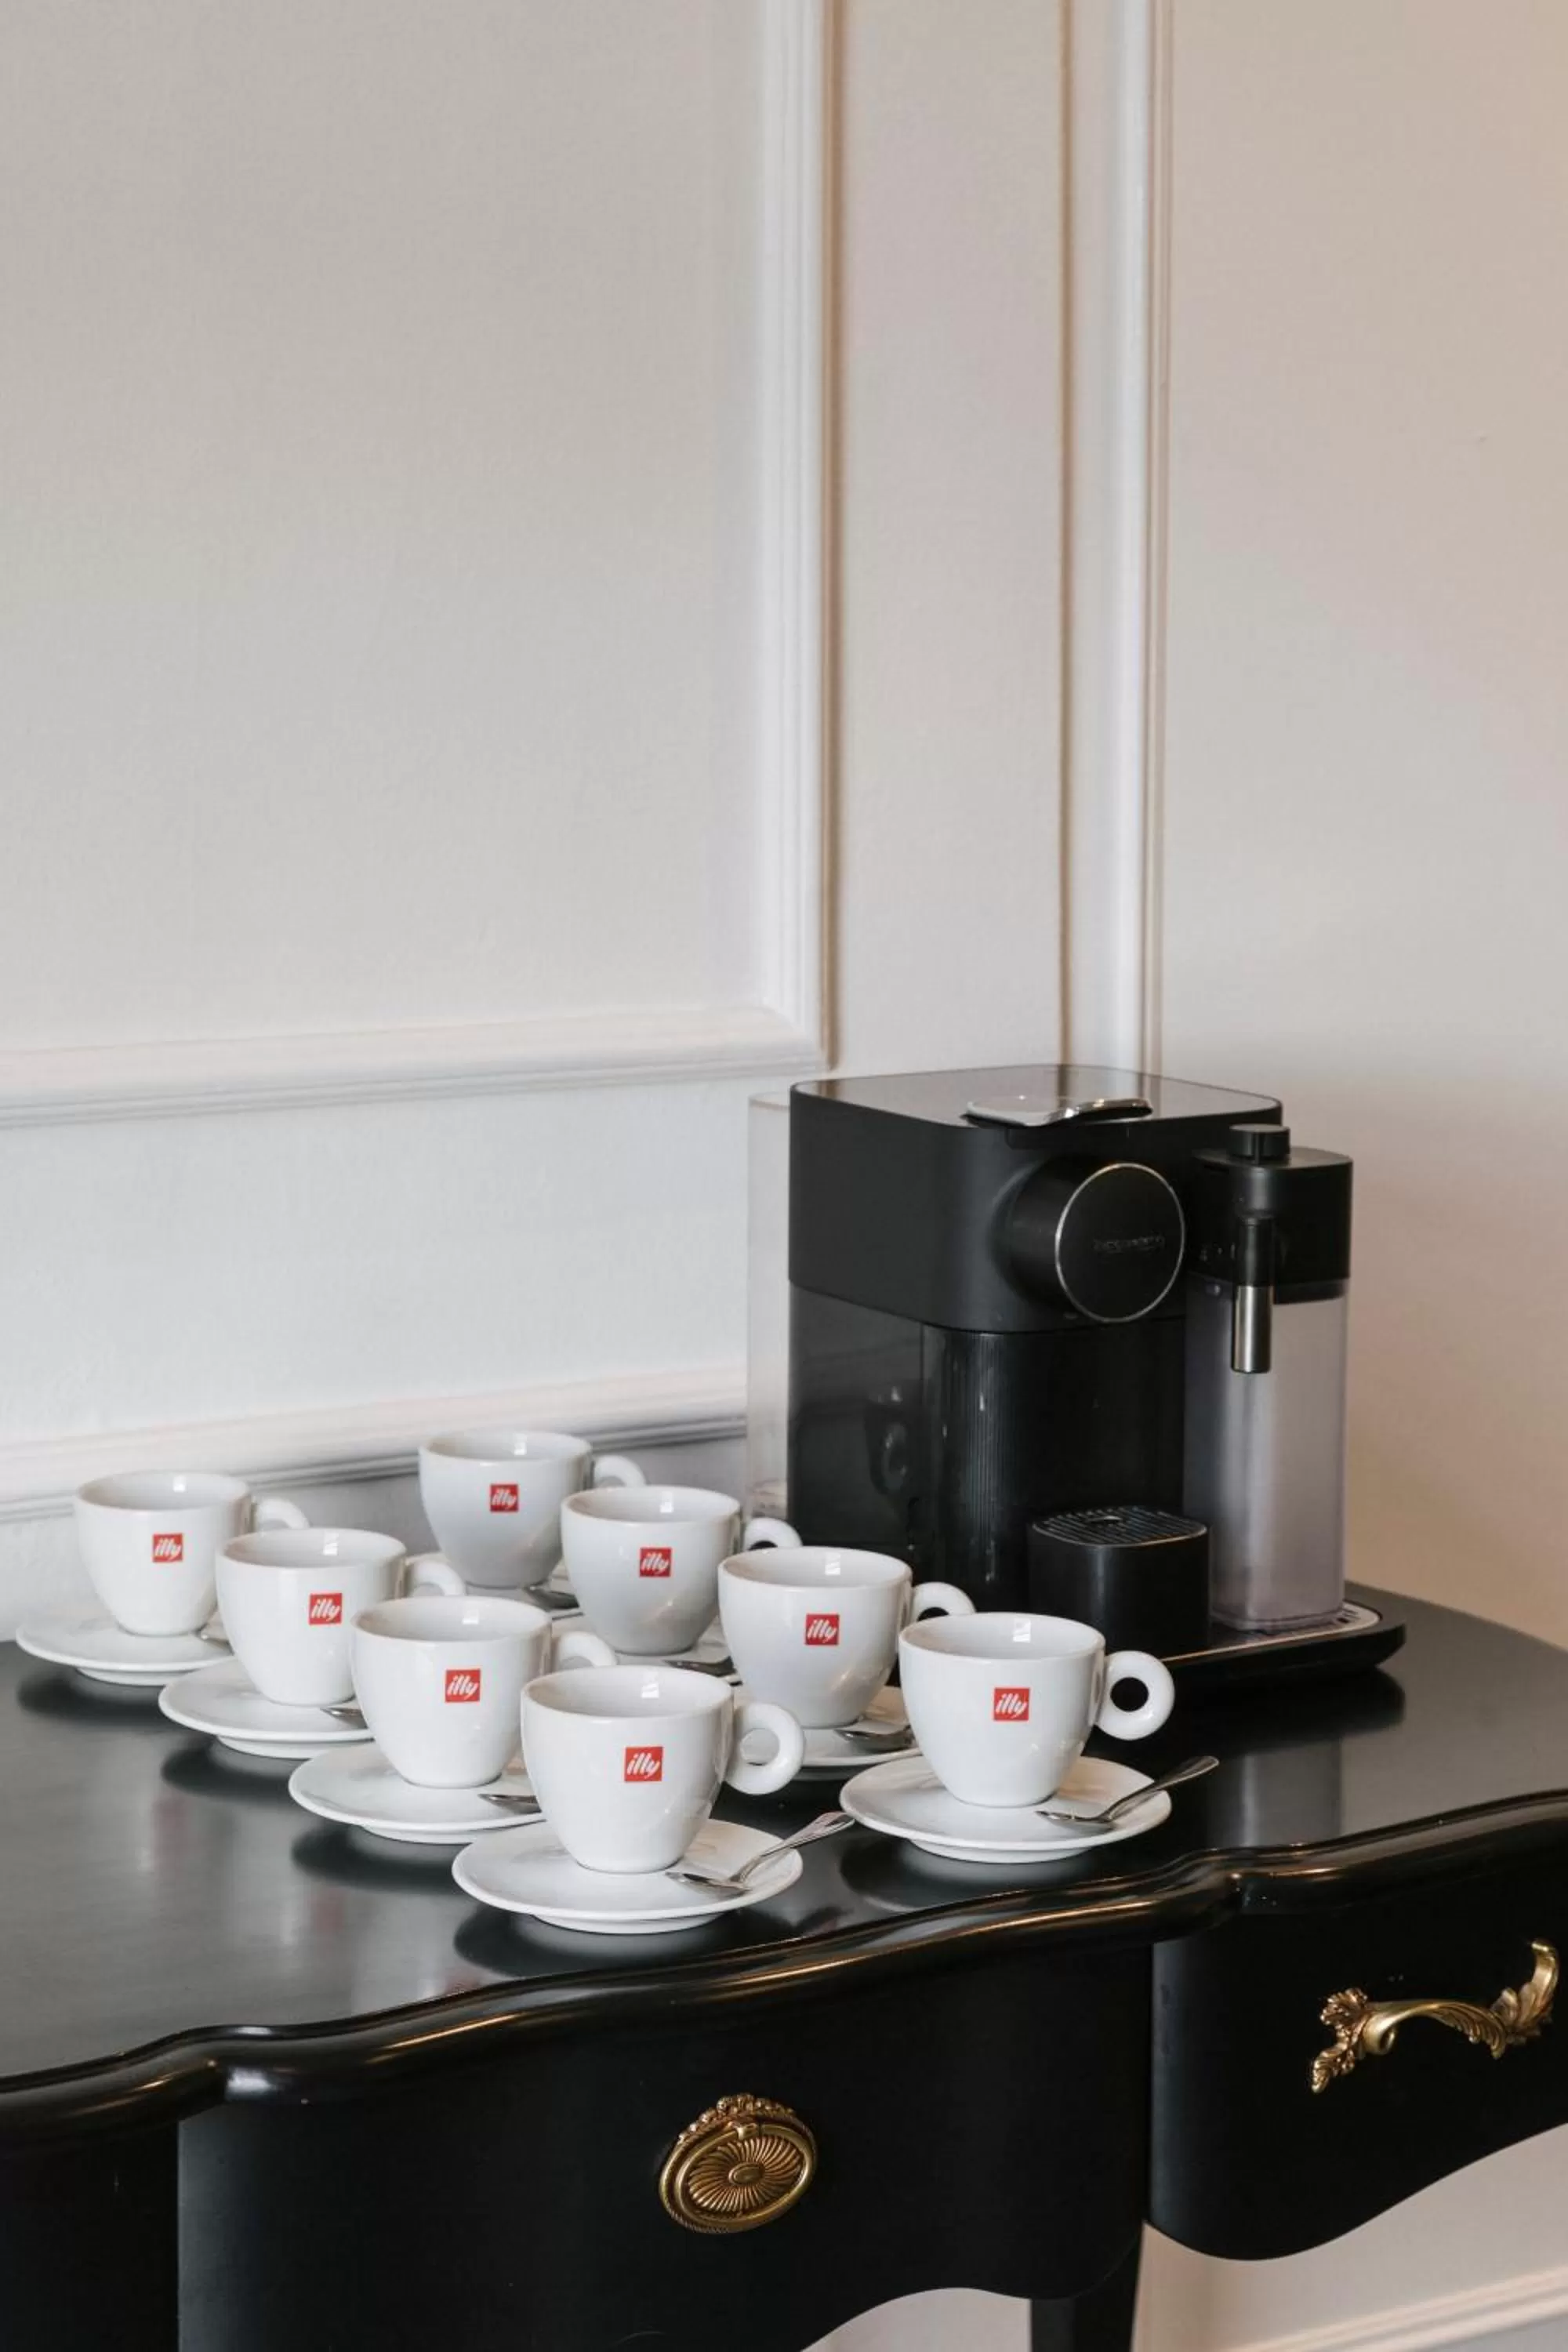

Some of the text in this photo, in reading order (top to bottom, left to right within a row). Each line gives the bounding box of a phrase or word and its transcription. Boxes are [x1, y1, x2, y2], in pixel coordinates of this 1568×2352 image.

[492, 1488, 516, 1508] illy
[154, 1537, 181, 1559] illy
[641, 1552, 670, 1574] illy
[311, 1598, 339, 1621] illy
[808, 1618, 837, 1643] illy
[448, 1674, 478, 1700] illy
[995, 1693, 1027, 1719] illy
[626, 1752, 660, 1779] illy
